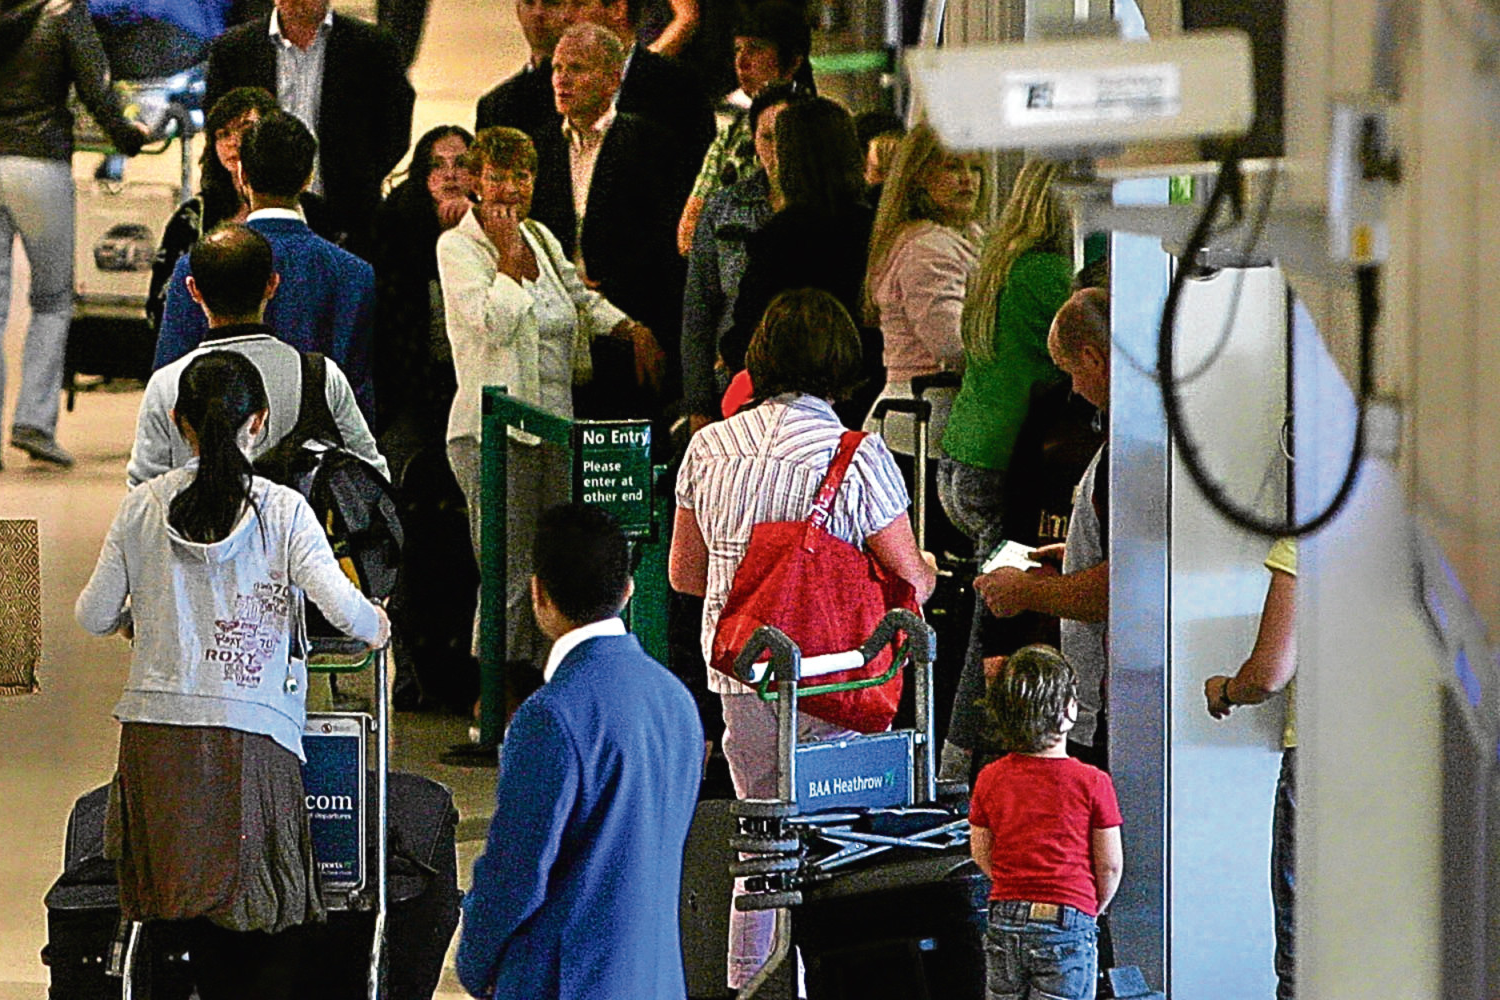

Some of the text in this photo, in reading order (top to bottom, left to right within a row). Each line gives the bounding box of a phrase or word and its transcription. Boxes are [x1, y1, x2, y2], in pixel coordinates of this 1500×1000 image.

[583, 430, 649, 447] No Entry
[583, 460, 622, 473] Please
[583, 476, 634, 488] enter at
[583, 489, 643, 503] other end
[205, 649, 257, 665] ROXY
[809, 776, 883, 798] BAA Heathrow
[304, 794, 353, 810] com
